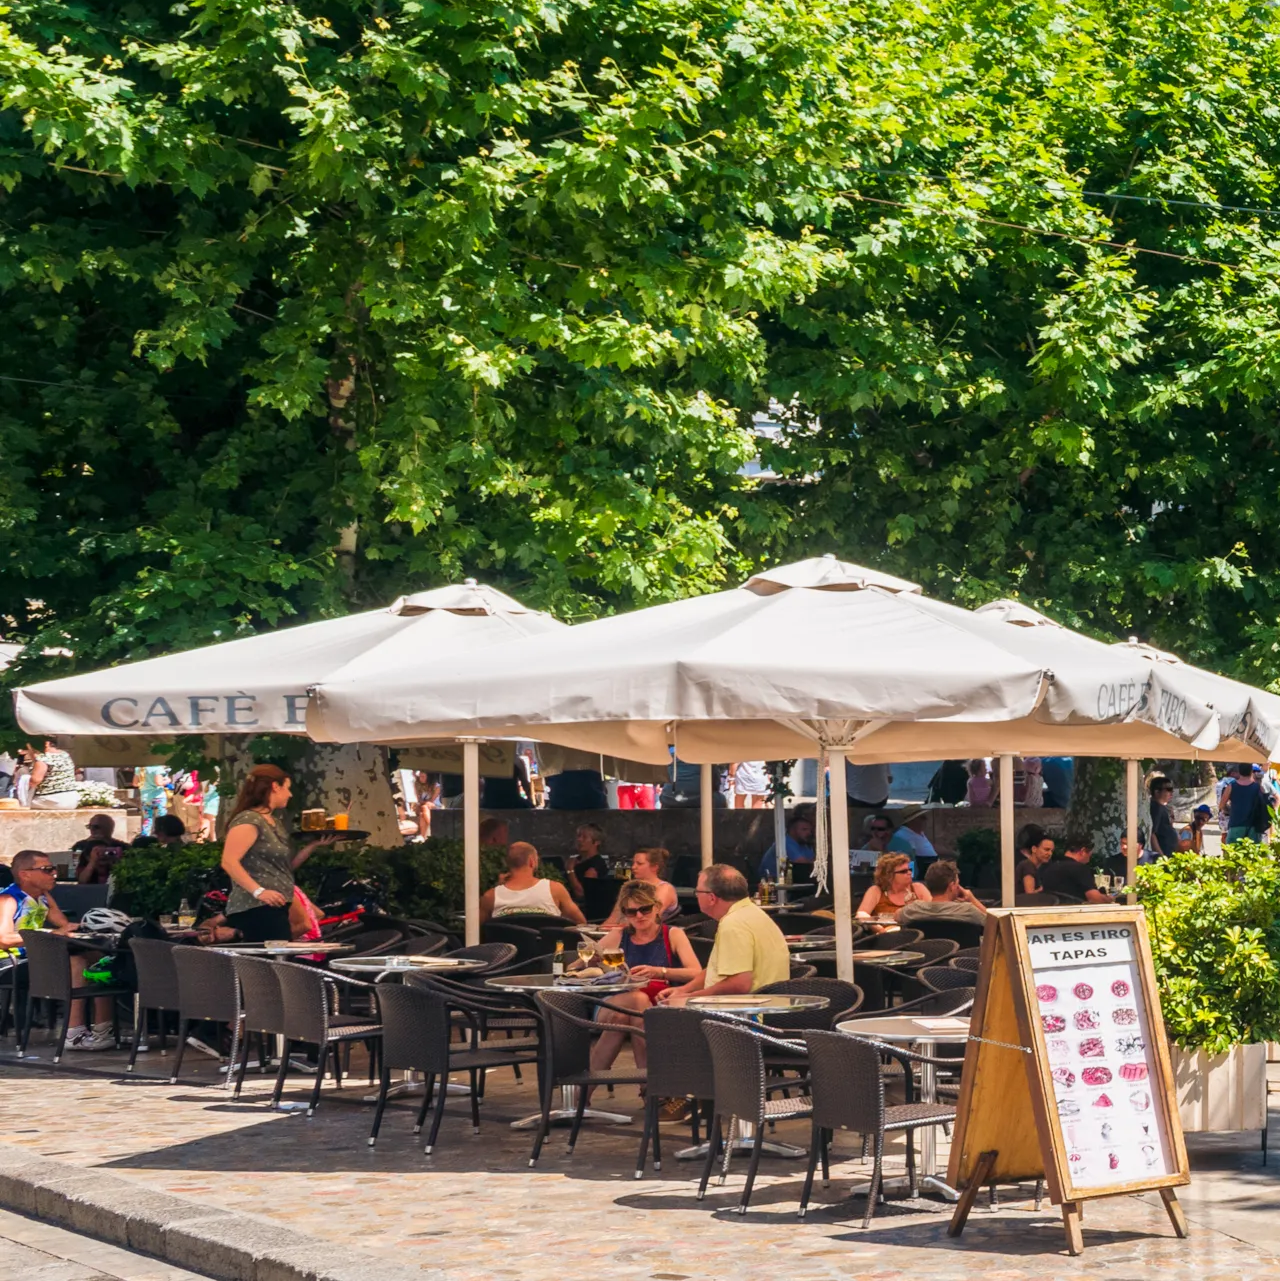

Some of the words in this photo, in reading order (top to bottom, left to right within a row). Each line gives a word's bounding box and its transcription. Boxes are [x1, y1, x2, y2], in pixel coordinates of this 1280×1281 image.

[101, 691, 259, 728] CAFÈ
[1158, 688, 1188, 728] FIRO
[1062, 931, 1085, 943] ES
[1090, 928, 1132, 941] FIRO
[1050, 947, 1108, 961] TAPAS
